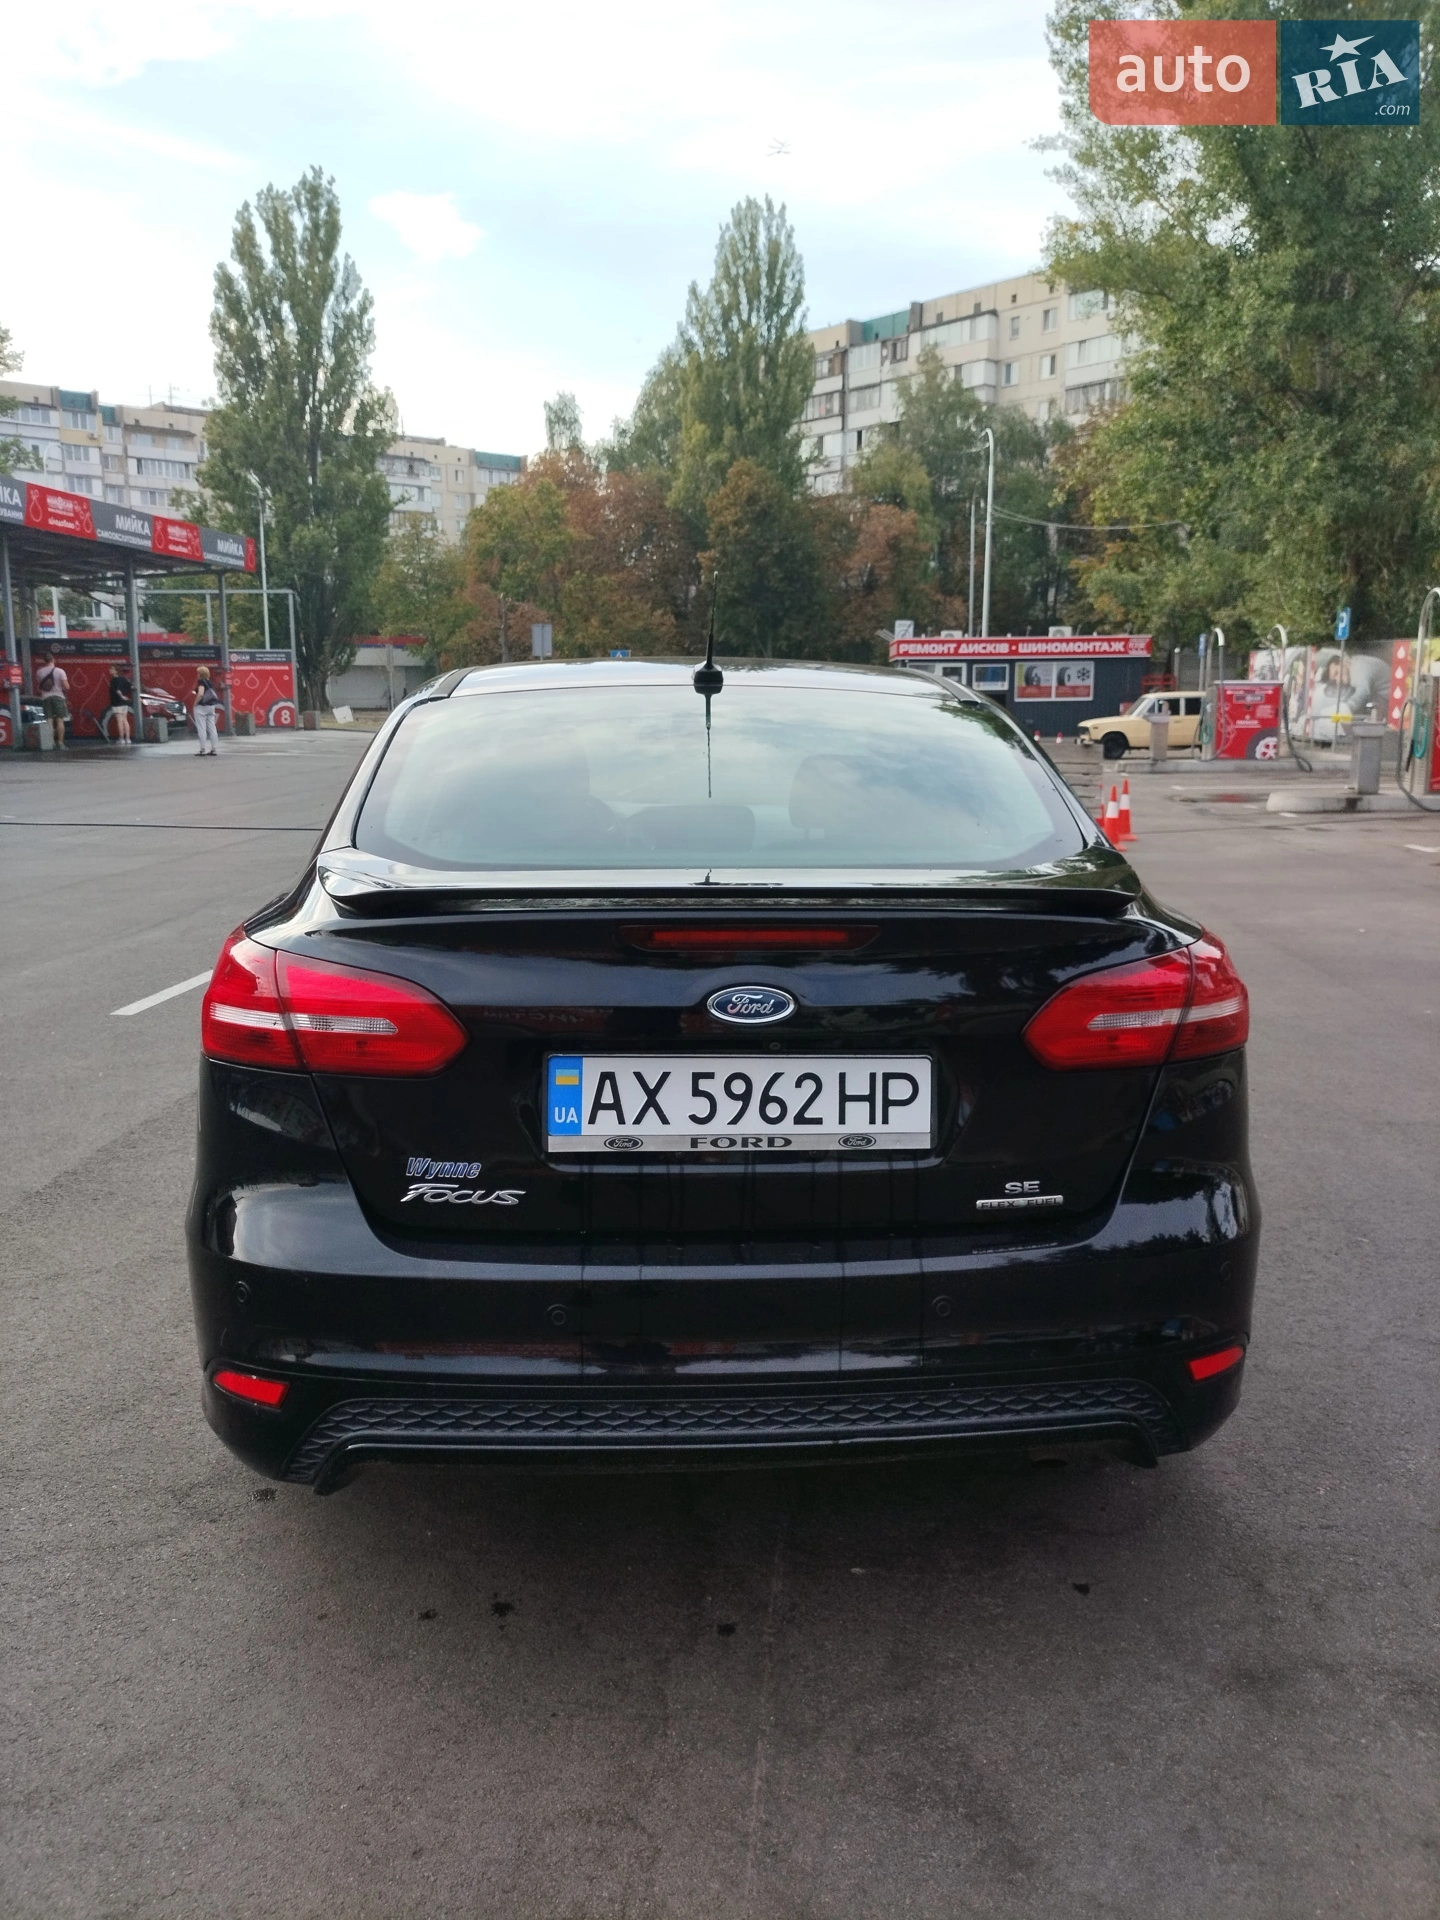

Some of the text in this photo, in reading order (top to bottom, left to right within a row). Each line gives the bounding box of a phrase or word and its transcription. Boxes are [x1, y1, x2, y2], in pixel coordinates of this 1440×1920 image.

[115, 514, 151, 536] МИЙКА
[217, 538, 245, 557] МИЙКА
[899, 643, 957, 654] РЕМОНТ
[958, 643, 1009, 654] ДИСКІВ
[1018, 641, 1125, 653] ШИНОМОНТАЖ
[281, 709, 291, 724] 8
[727, 994, 775, 1014] Ford
[588, 1071, 919, 1125] AX 5962 HP
[555, 1107, 578, 1123] UA
[690, 1136, 792, 1148] FORD
[406, 1157, 482, 1179] Wynne
[1004, 1181, 1040, 1194] SE
[980, 1200, 1016, 1209] FLEX
